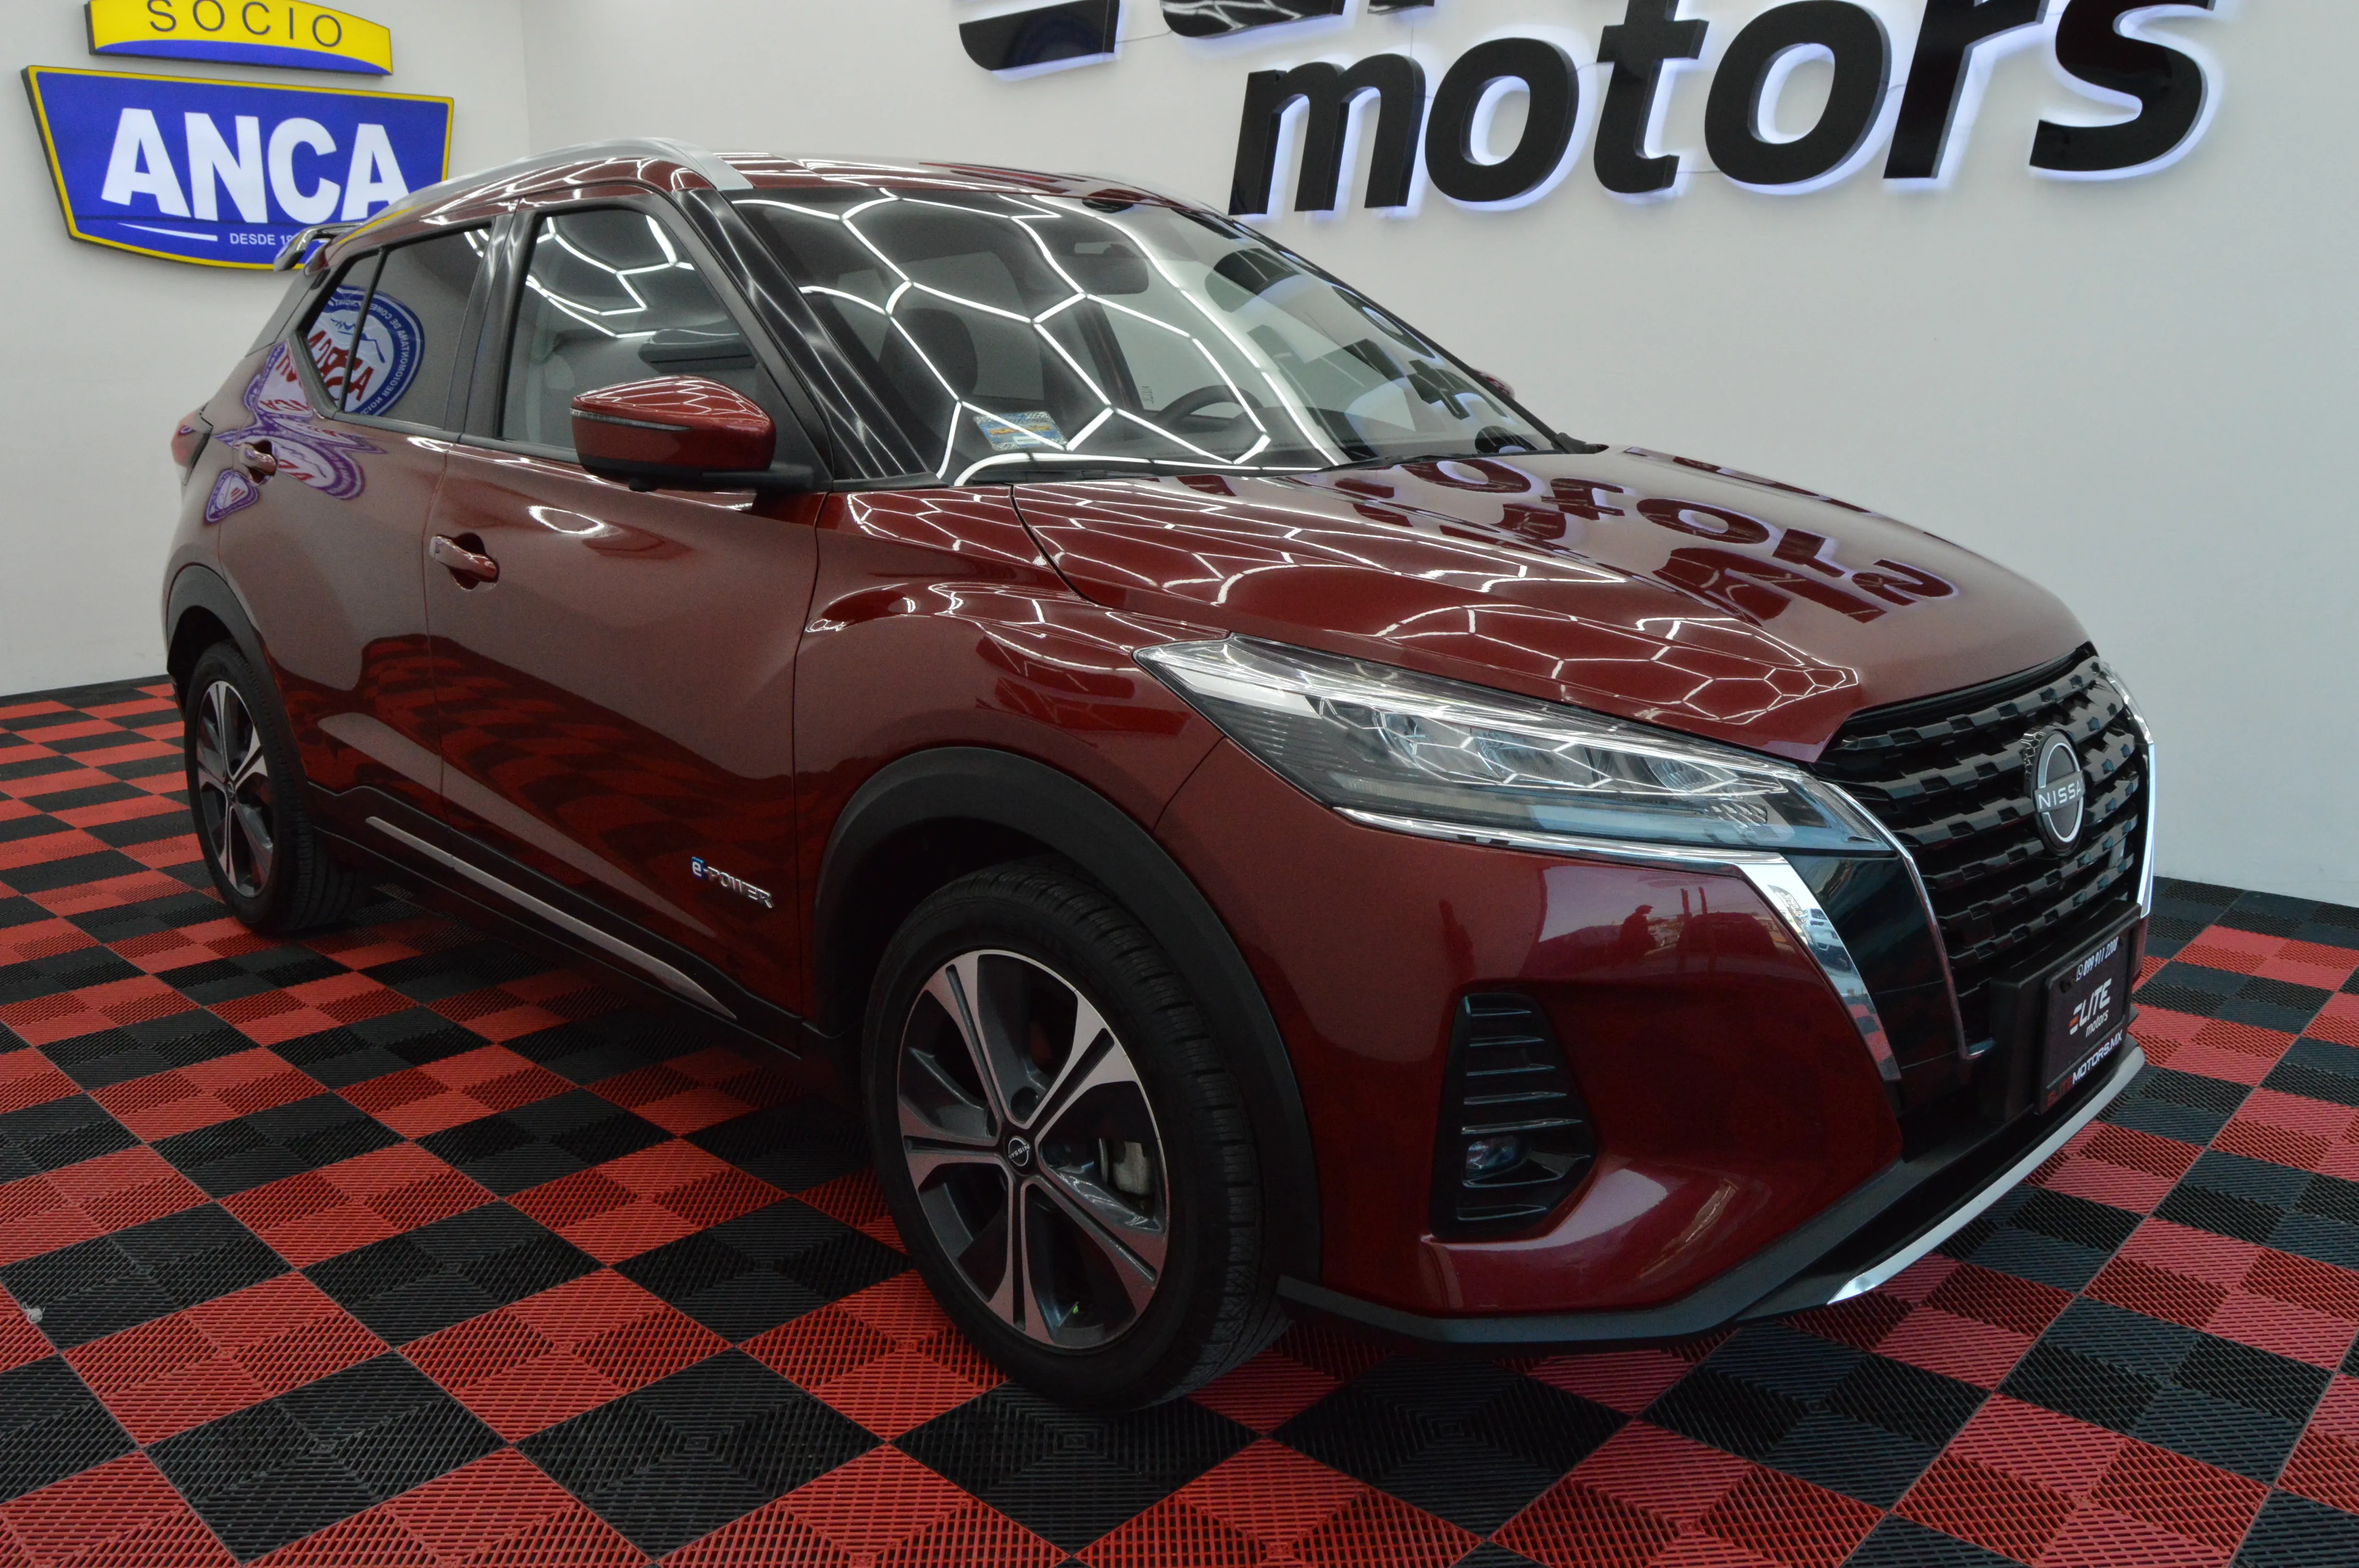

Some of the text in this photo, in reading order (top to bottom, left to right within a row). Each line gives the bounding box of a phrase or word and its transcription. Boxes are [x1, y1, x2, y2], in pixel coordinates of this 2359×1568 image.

[147, 0, 342, 48] SOCIO
[1228, 0, 2217, 215] motors
[101, 108, 410, 224] ANCA
[230, 233, 276, 245] DESDE
[2038, 778, 2083, 810] NISSA
[2069, 978, 2112, 1035] ELITE
[2085, 1009, 2109, 1038] motors
